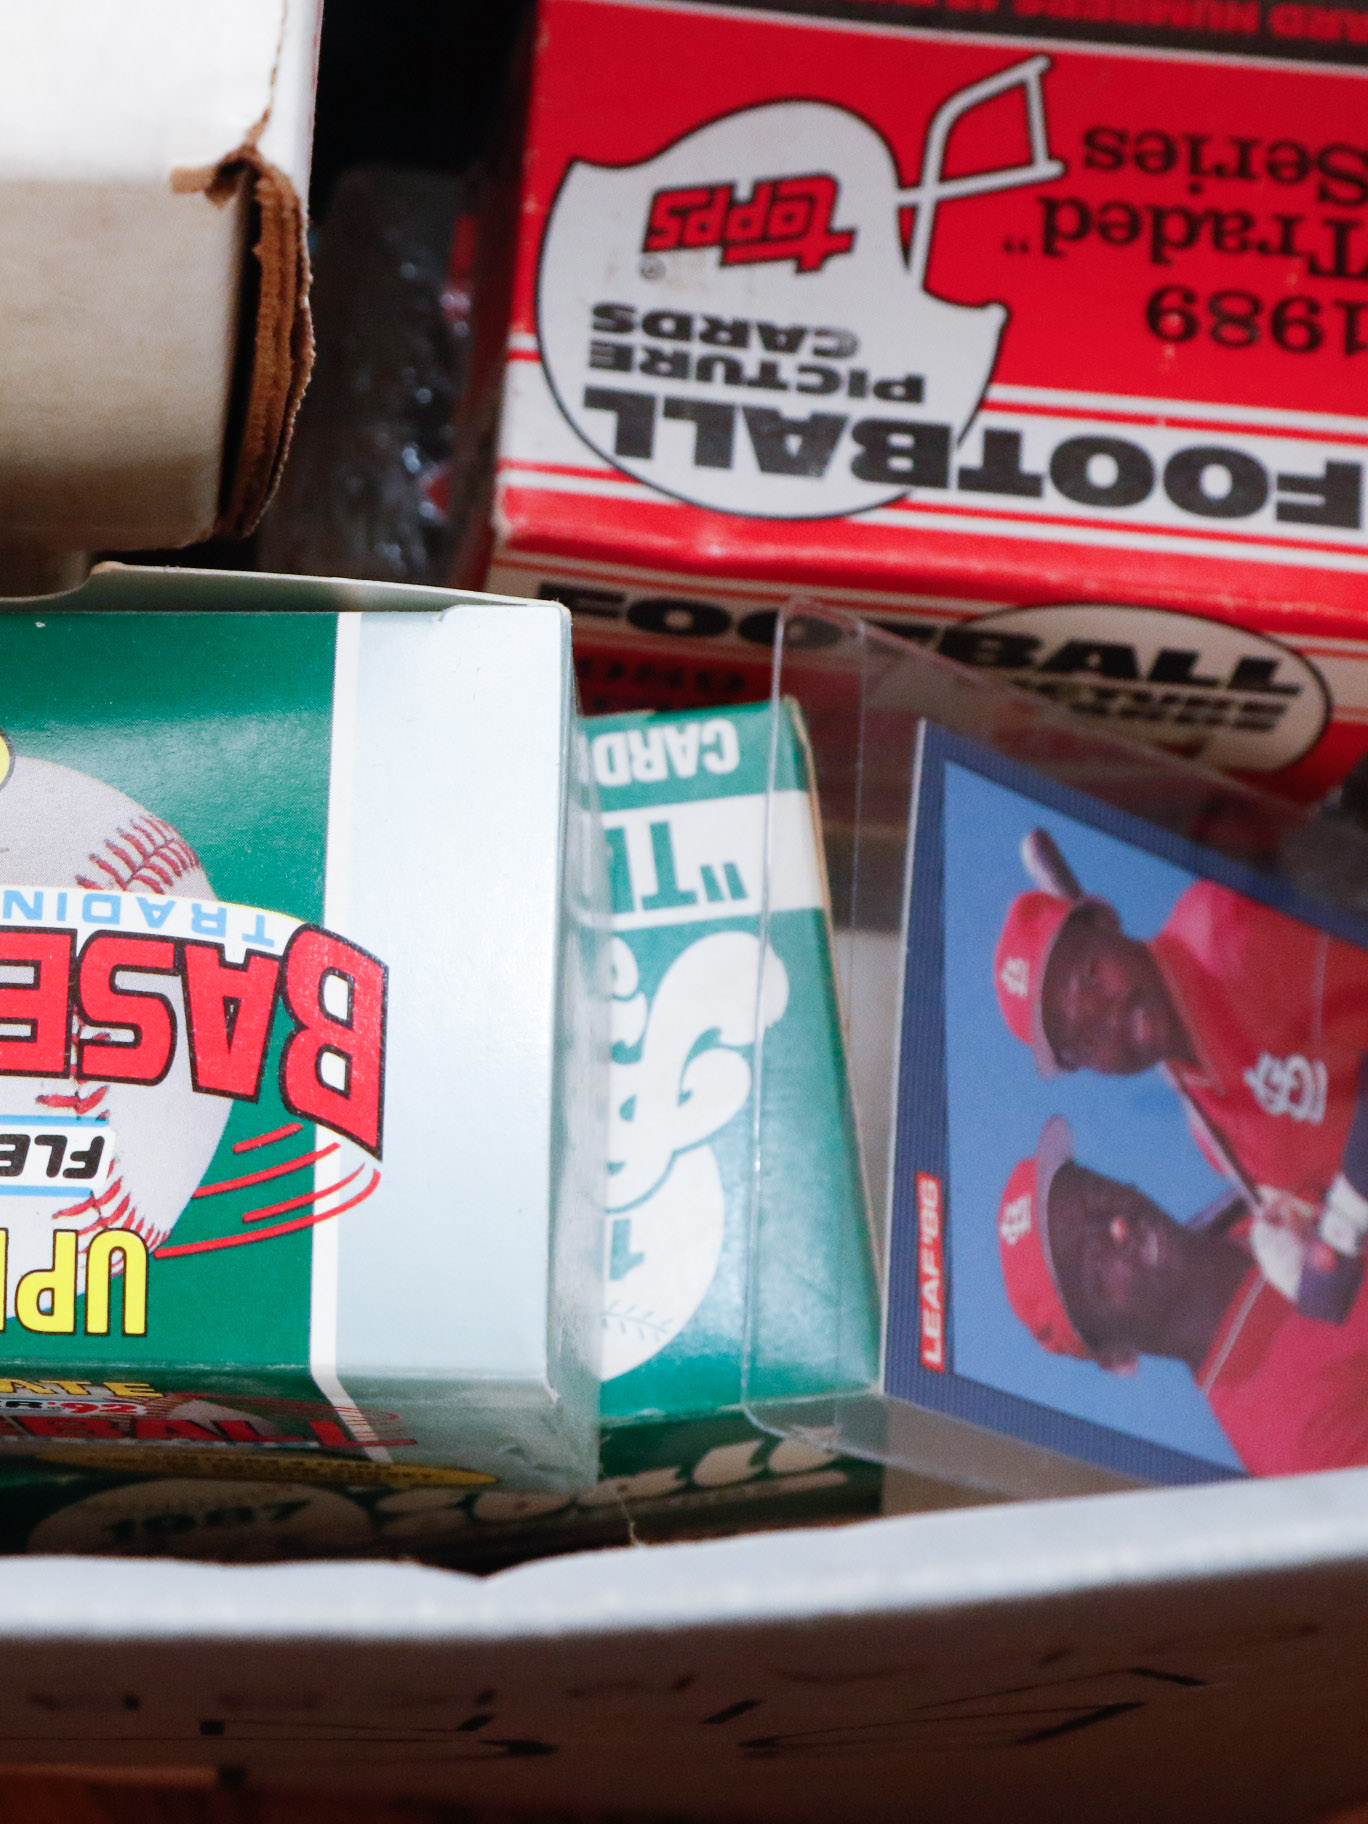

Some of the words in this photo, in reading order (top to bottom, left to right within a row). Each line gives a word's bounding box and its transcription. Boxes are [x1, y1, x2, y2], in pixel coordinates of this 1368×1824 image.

[1084, 126, 1368, 208] Series
[592, 300, 861, 360] CARDS
[1146, 285, 1368, 357] 1989
[587, 340, 927, 405] PICTURE
[583, 385, 1367, 532] FOOTBALL
